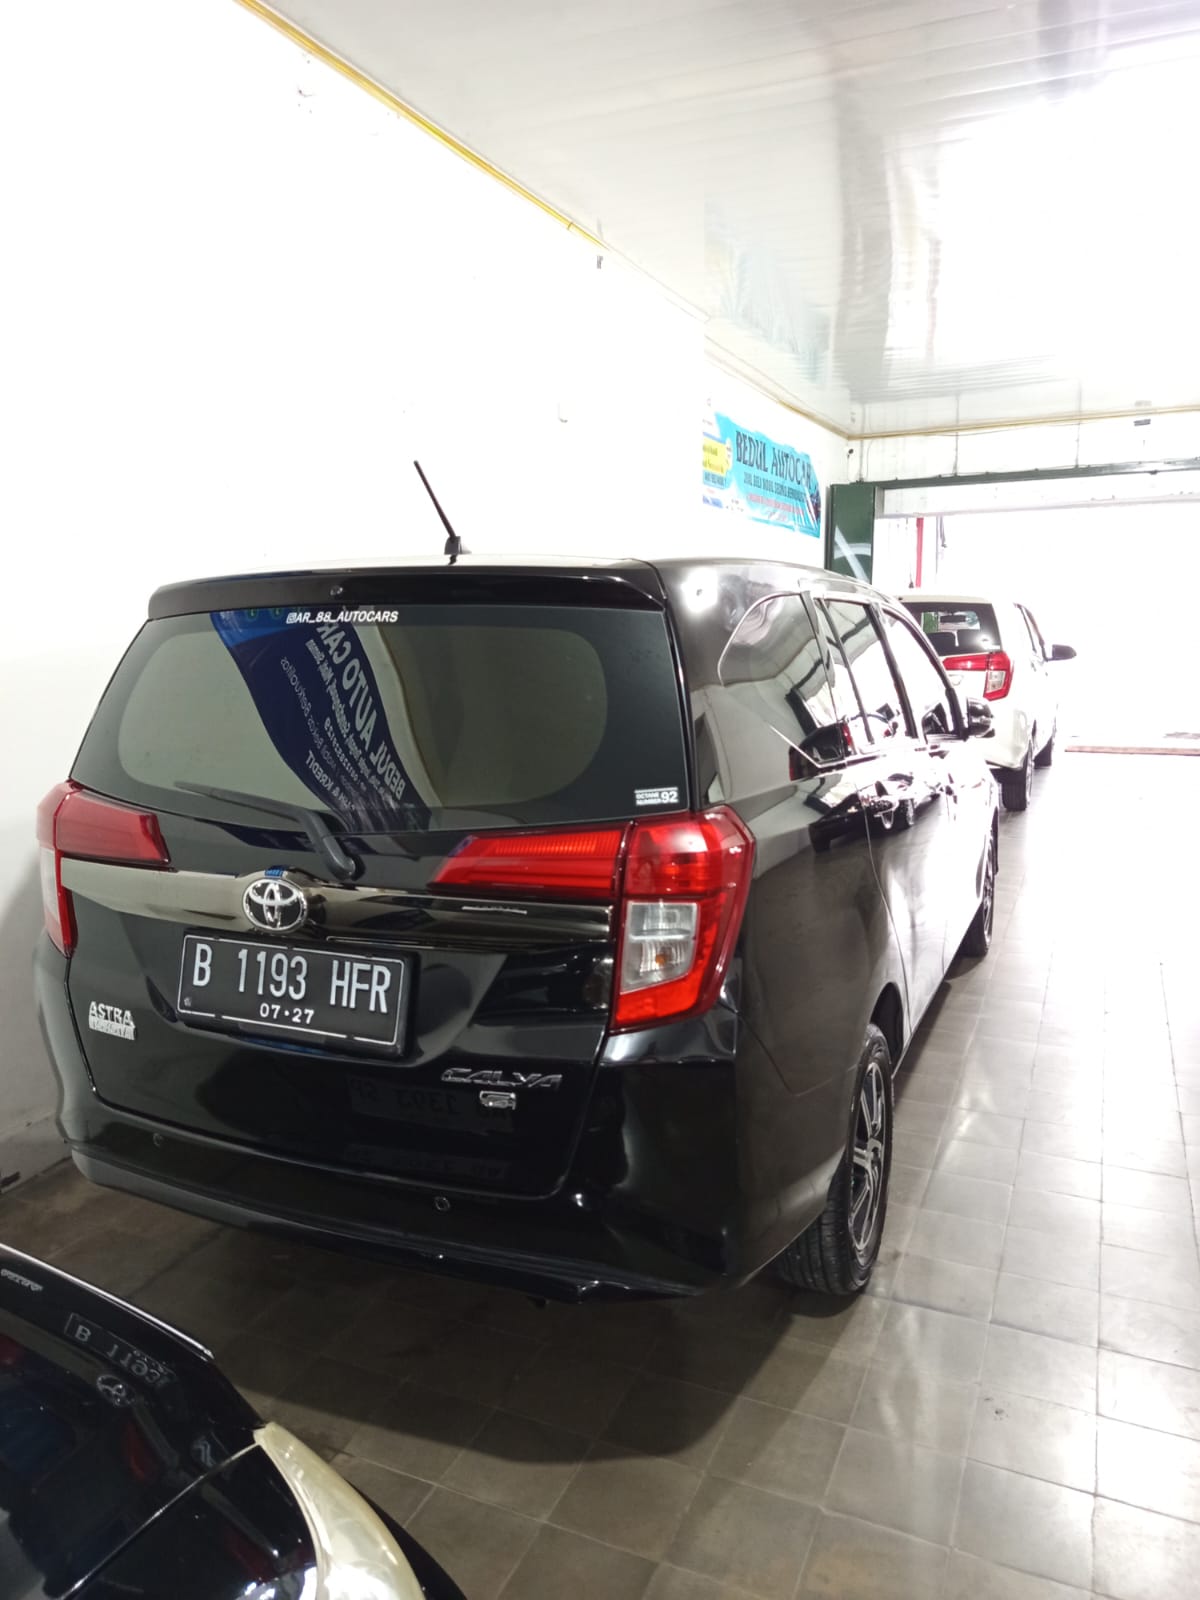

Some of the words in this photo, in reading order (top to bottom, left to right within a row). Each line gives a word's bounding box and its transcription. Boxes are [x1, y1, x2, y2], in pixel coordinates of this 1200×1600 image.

[736, 431, 768, 472] BEDUL
[661, 791, 678, 803] 92
[192, 943, 213, 987] B
[238, 949, 308, 1001] 1193
[329, 960, 392, 1014] HFR
[88, 1000, 136, 1029] ASTRA
